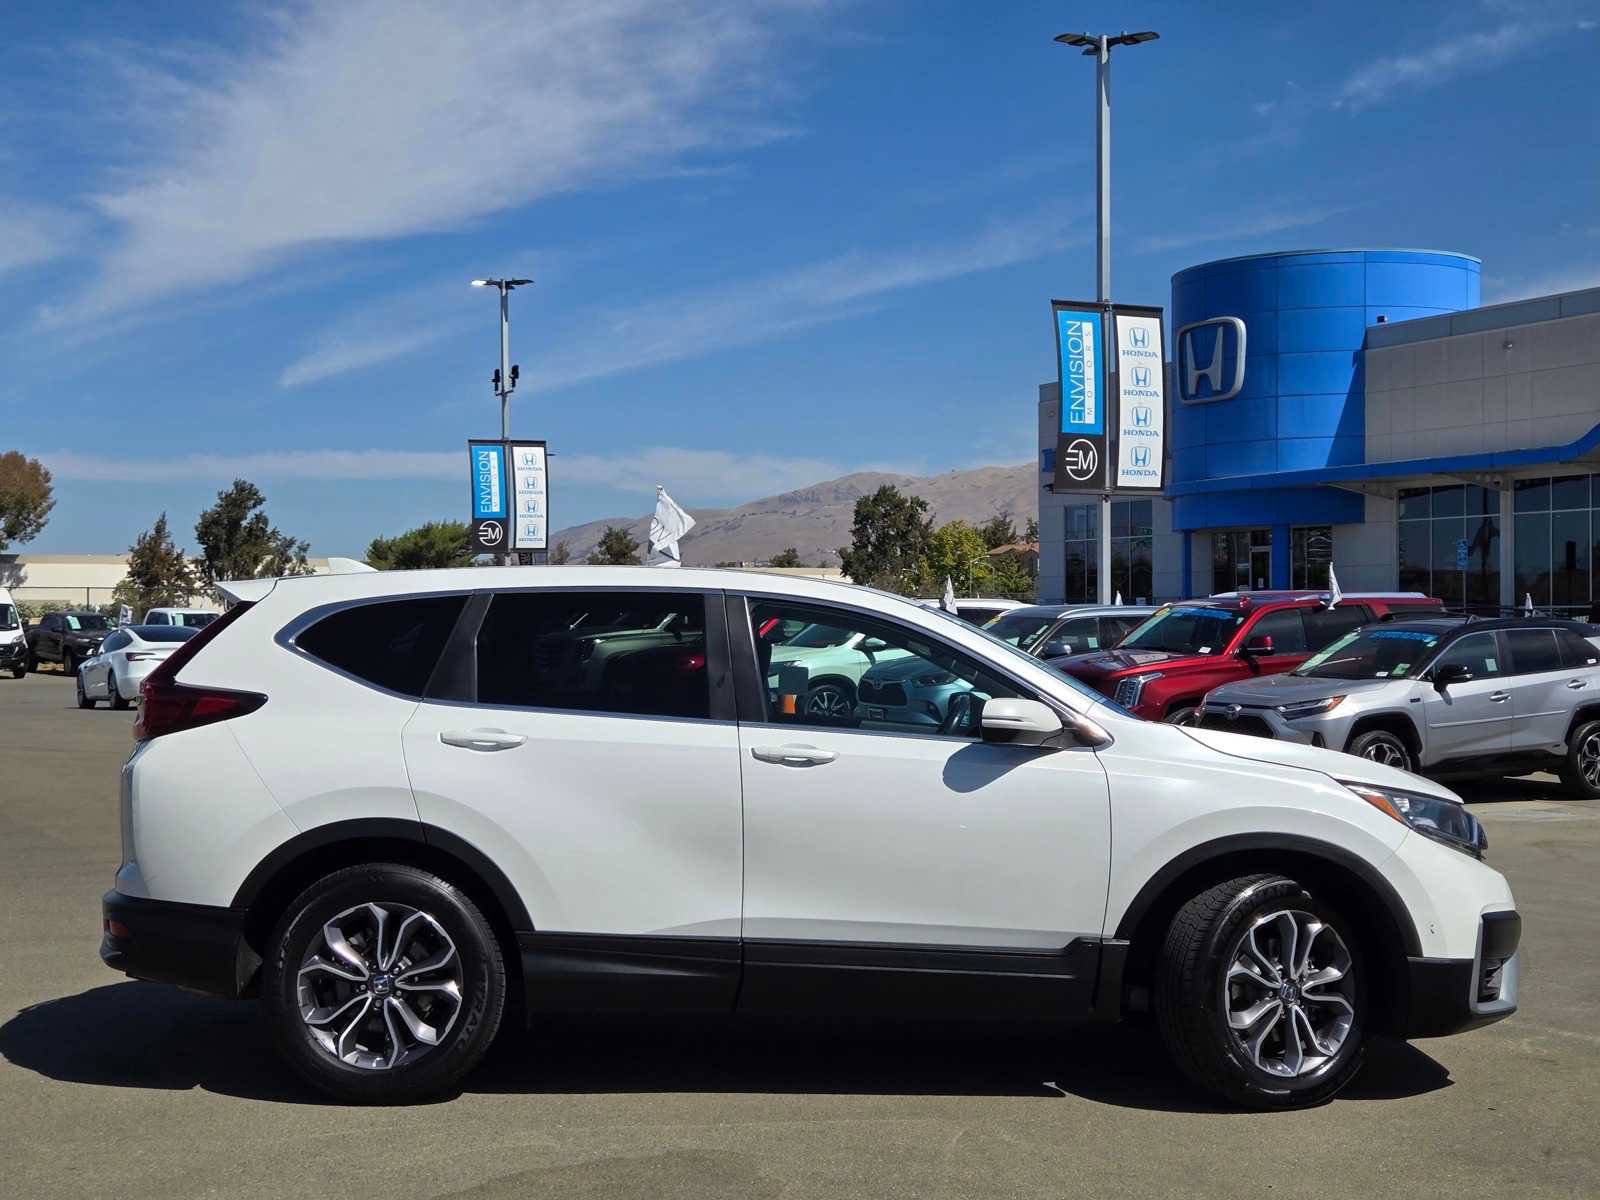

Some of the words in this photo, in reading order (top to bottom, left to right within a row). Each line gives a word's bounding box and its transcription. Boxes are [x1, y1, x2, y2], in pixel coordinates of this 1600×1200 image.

[1121, 349, 1158, 358] HONDA
[1066, 320, 1085, 424] ENVISION
[1085, 331, 1093, 416] MOTORS
[1123, 389, 1160, 398] HONDA
[1123, 429, 1160, 437] HONDA
[1121, 468, 1158, 477] HONDA
[478, 450, 491, 513] ENVISION
